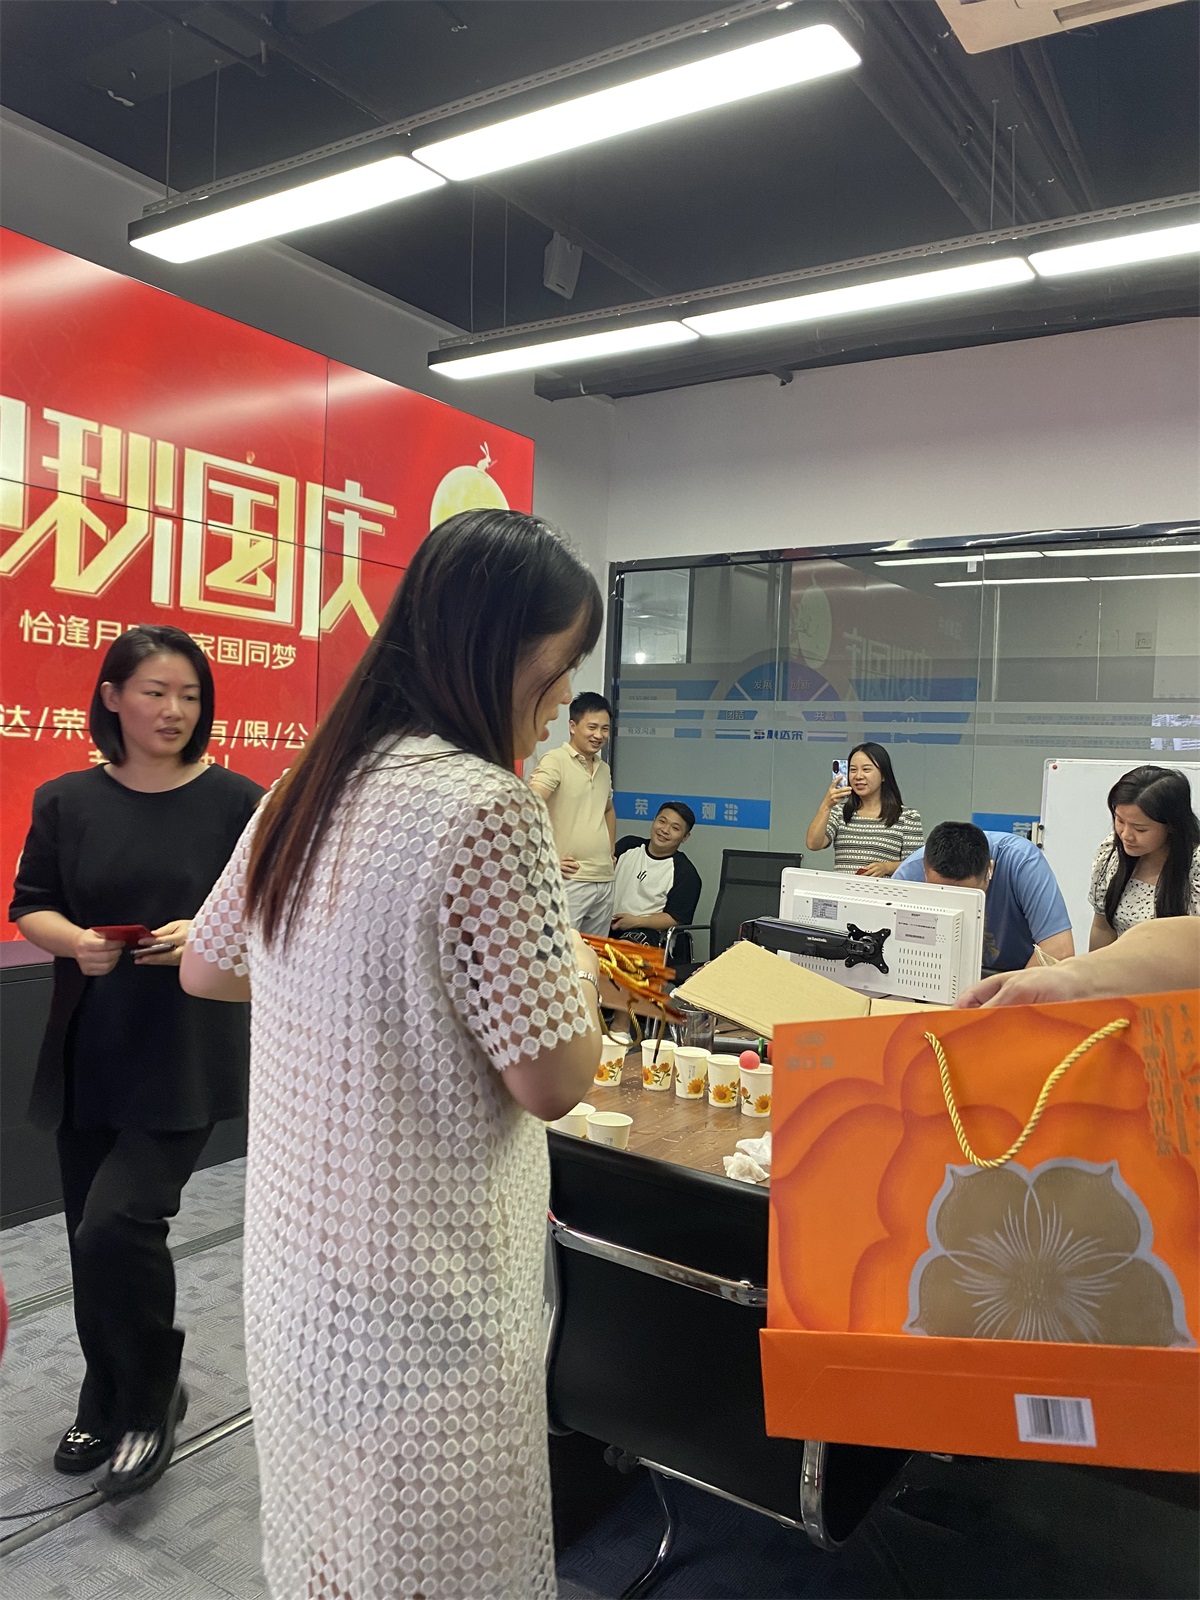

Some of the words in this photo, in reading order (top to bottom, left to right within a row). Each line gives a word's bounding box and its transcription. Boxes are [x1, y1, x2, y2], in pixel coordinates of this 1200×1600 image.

[0, 395, 397, 639] 秋国庆
[19, 609, 140, 650] 恰逢月
[753, 679, 773, 690] 发展
[790, 680, 811, 691] 创新
